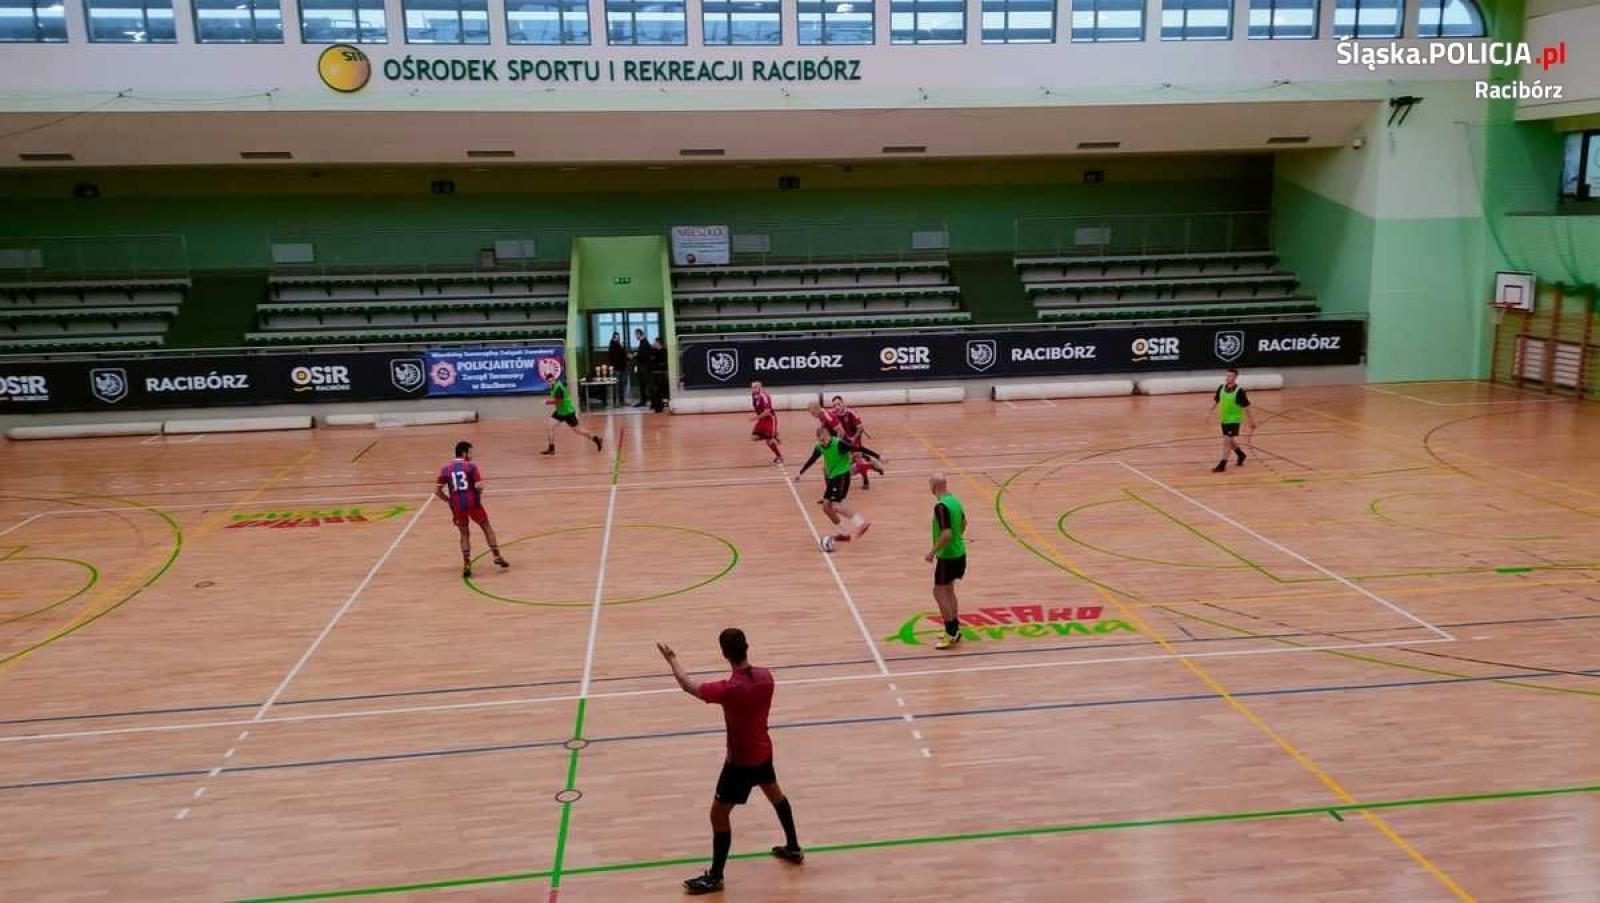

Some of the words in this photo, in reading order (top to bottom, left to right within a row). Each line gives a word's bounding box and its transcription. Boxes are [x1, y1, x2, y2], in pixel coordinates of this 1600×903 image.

[383, 55, 498, 82] OŚRODEK
[508, 59, 600, 82] SPORTU
[609, 60, 615, 81] I
[624, 60, 743, 82] REKREACJI
[752, 56, 861, 81] RACIBÓRZ
[1011, 342, 1096, 361] RACIBÓRZ
[1131, 337, 1180, 355] OSiR
[1258, 335, 1341, 352] RACIBÓRZ
[457, 357, 535, 371] POLICJANTÓW
[754, 352, 843, 370] RACIBÓRZ
[880, 346, 930, 365] OSiR
[145, 371, 249, 392] RACIBÓRZ
[291, 365, 350, 385] OSiR
[451, 471, 468, 491] 13
